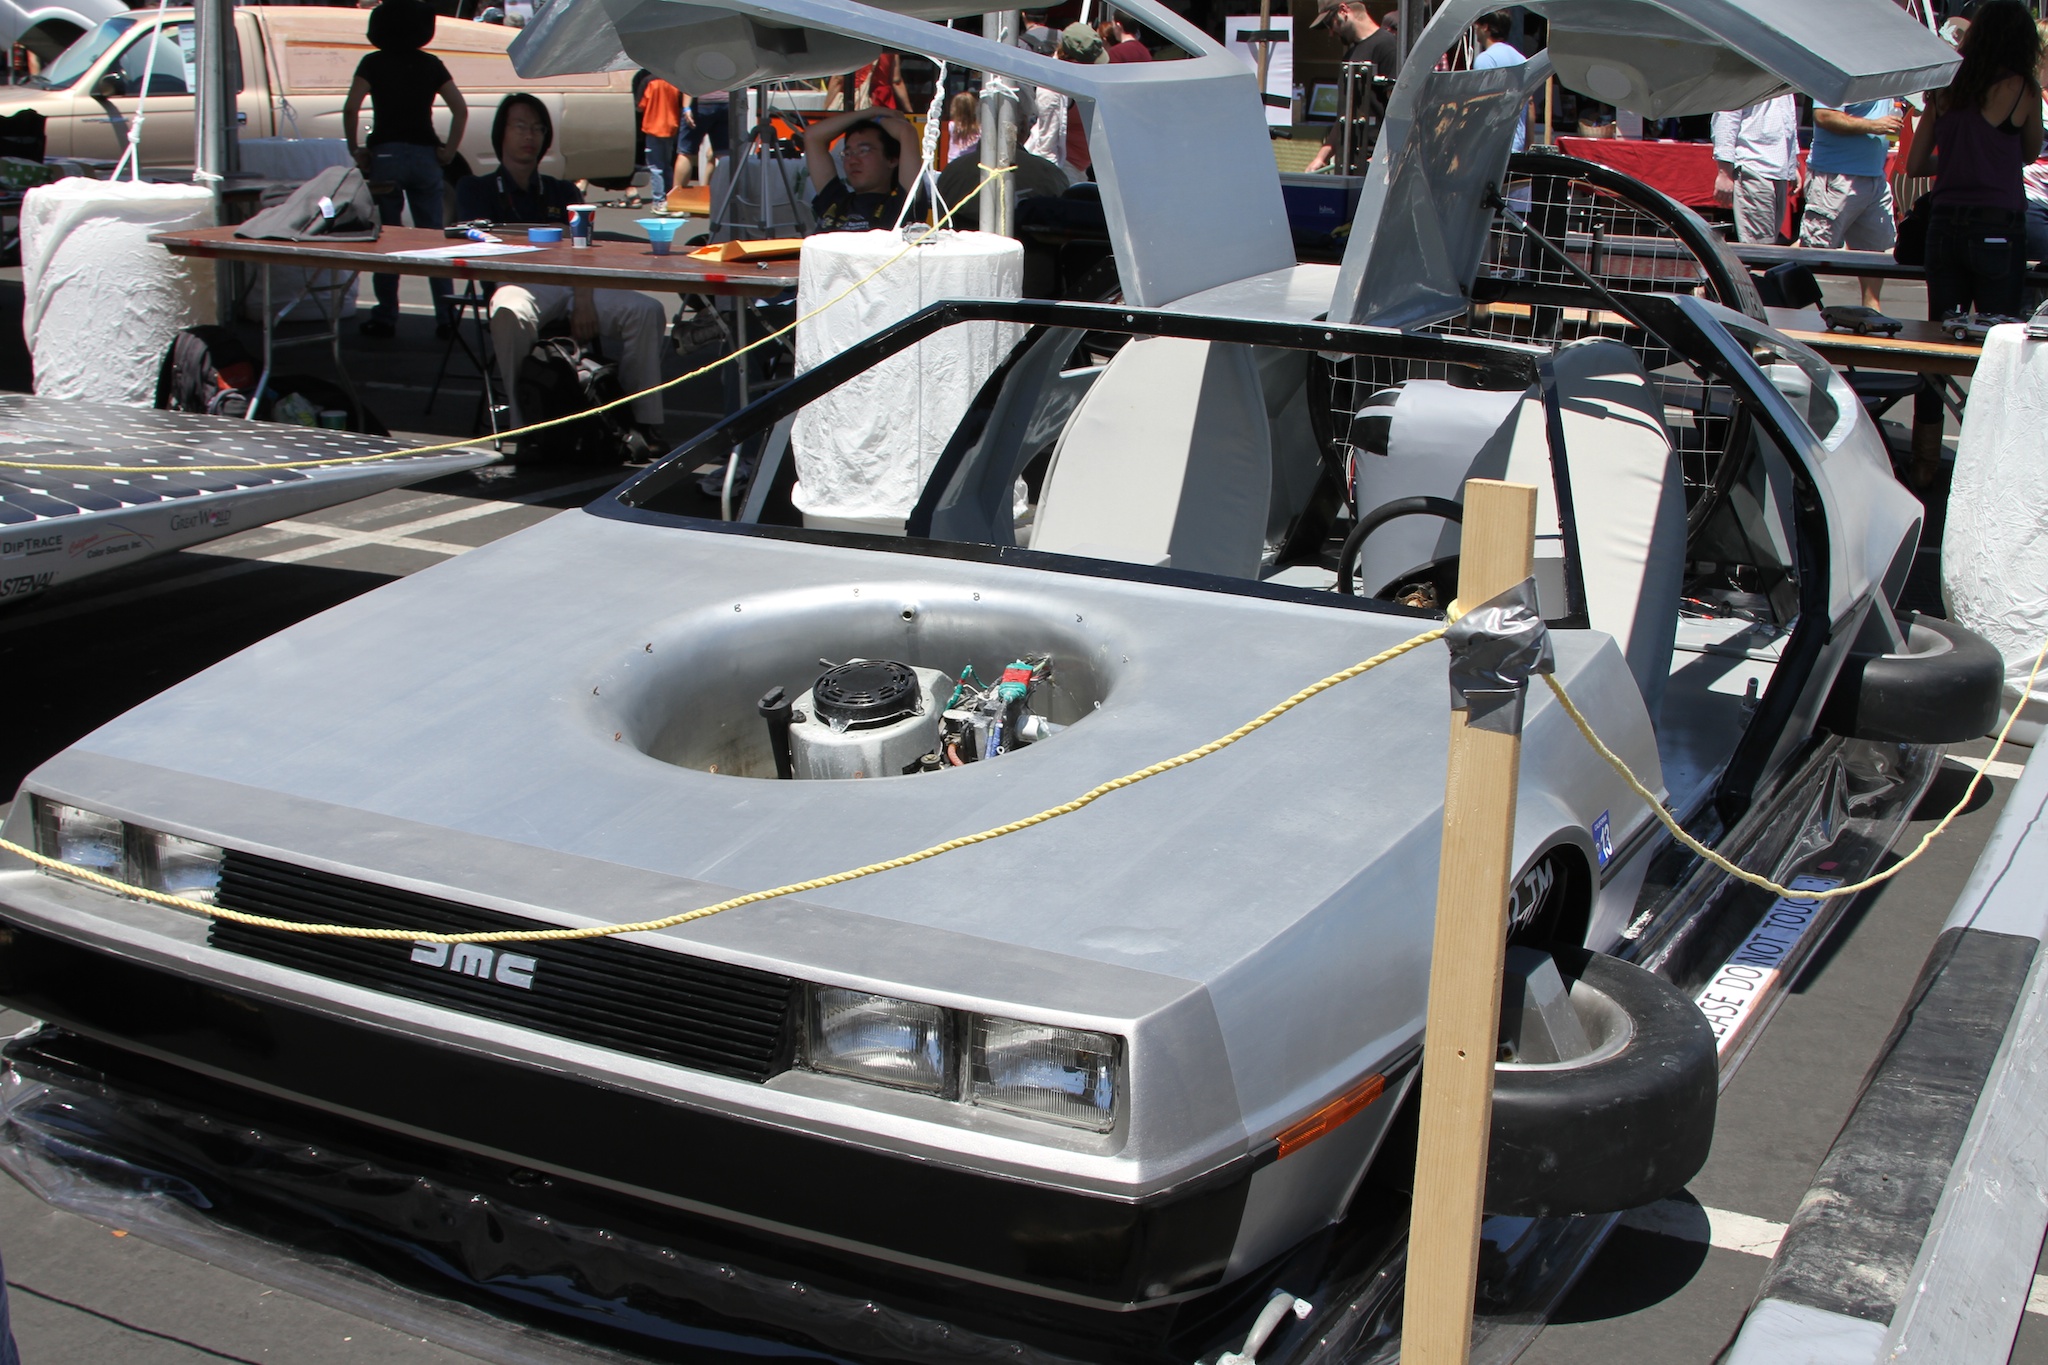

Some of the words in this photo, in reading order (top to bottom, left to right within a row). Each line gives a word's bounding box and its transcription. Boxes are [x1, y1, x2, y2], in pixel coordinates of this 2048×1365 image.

[171, 515, 197, 531] GREAT
[87, 548, 105, 559] Color
[0, 571, 54, 597] STENAL
[1600, 823, 1613, 859] 13
[1736, 933, 1791, 967] NOT
[1715, 966, 1763, 991] DO
[1699, 992, 1745, 1041] ASE
